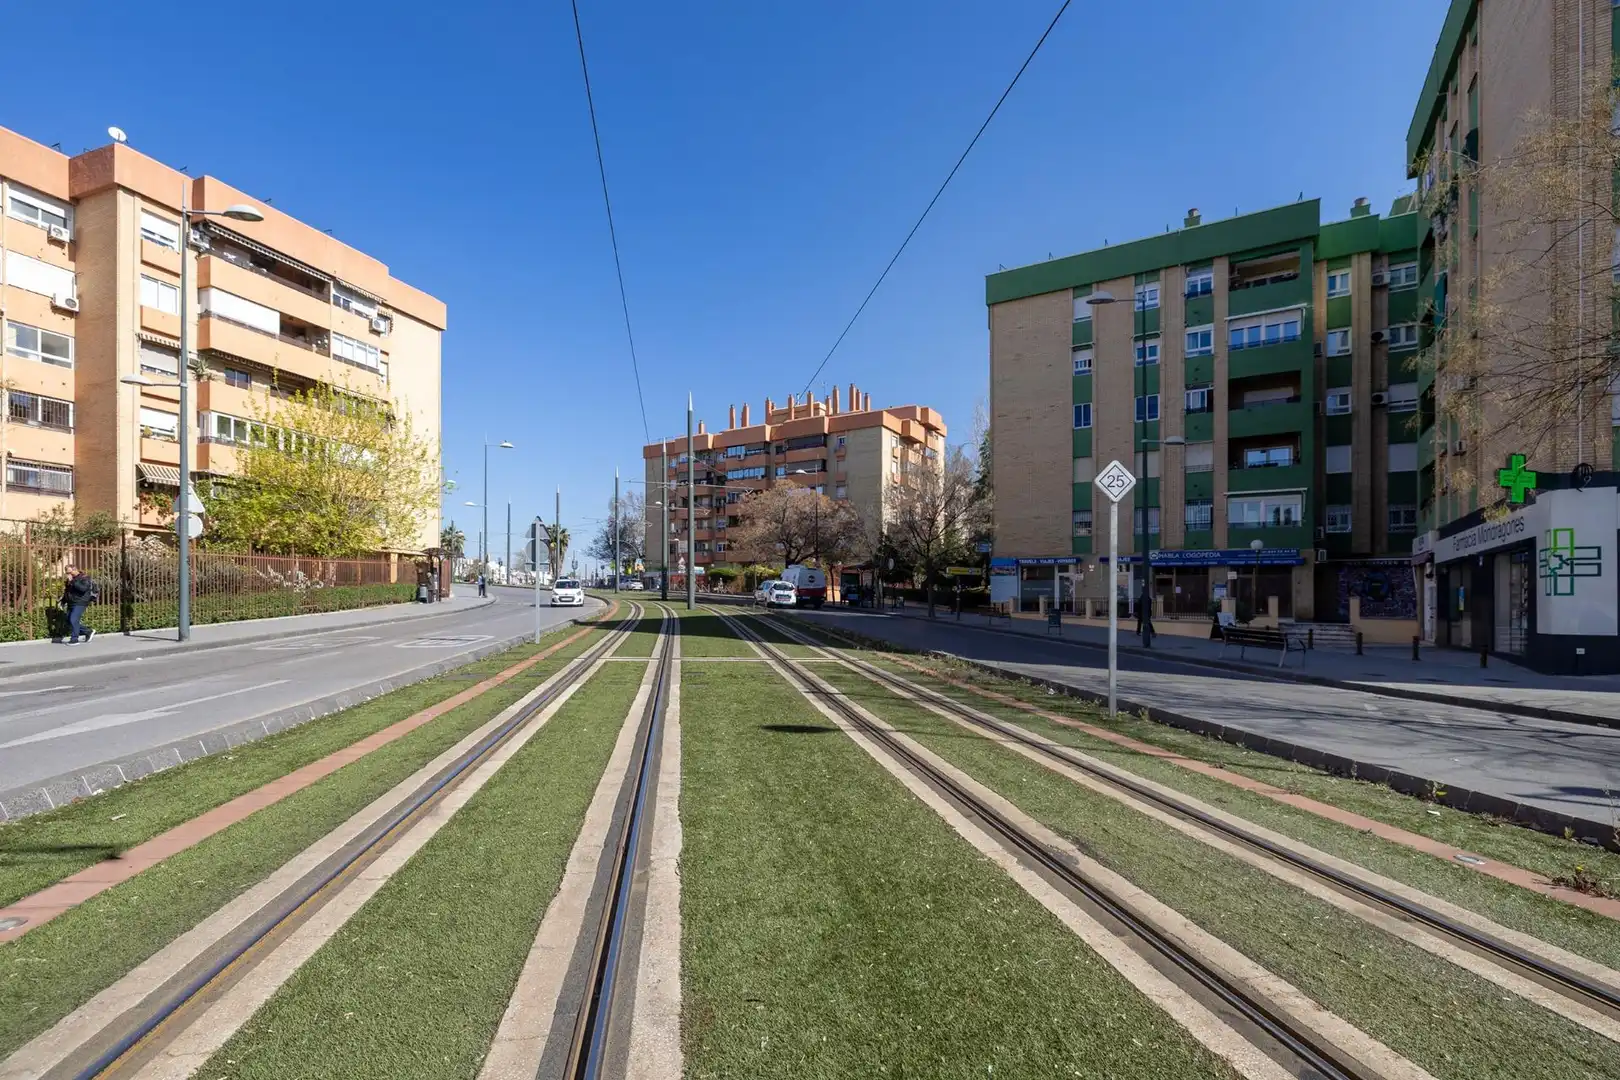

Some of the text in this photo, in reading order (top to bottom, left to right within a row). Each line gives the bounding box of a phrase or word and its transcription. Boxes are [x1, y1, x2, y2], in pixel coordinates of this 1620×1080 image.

[1107, 474, 1125, 488] 25
[1452, 531, 1477, 551] Farmacia
[1477, 516, 1525, 544] Mondragones
